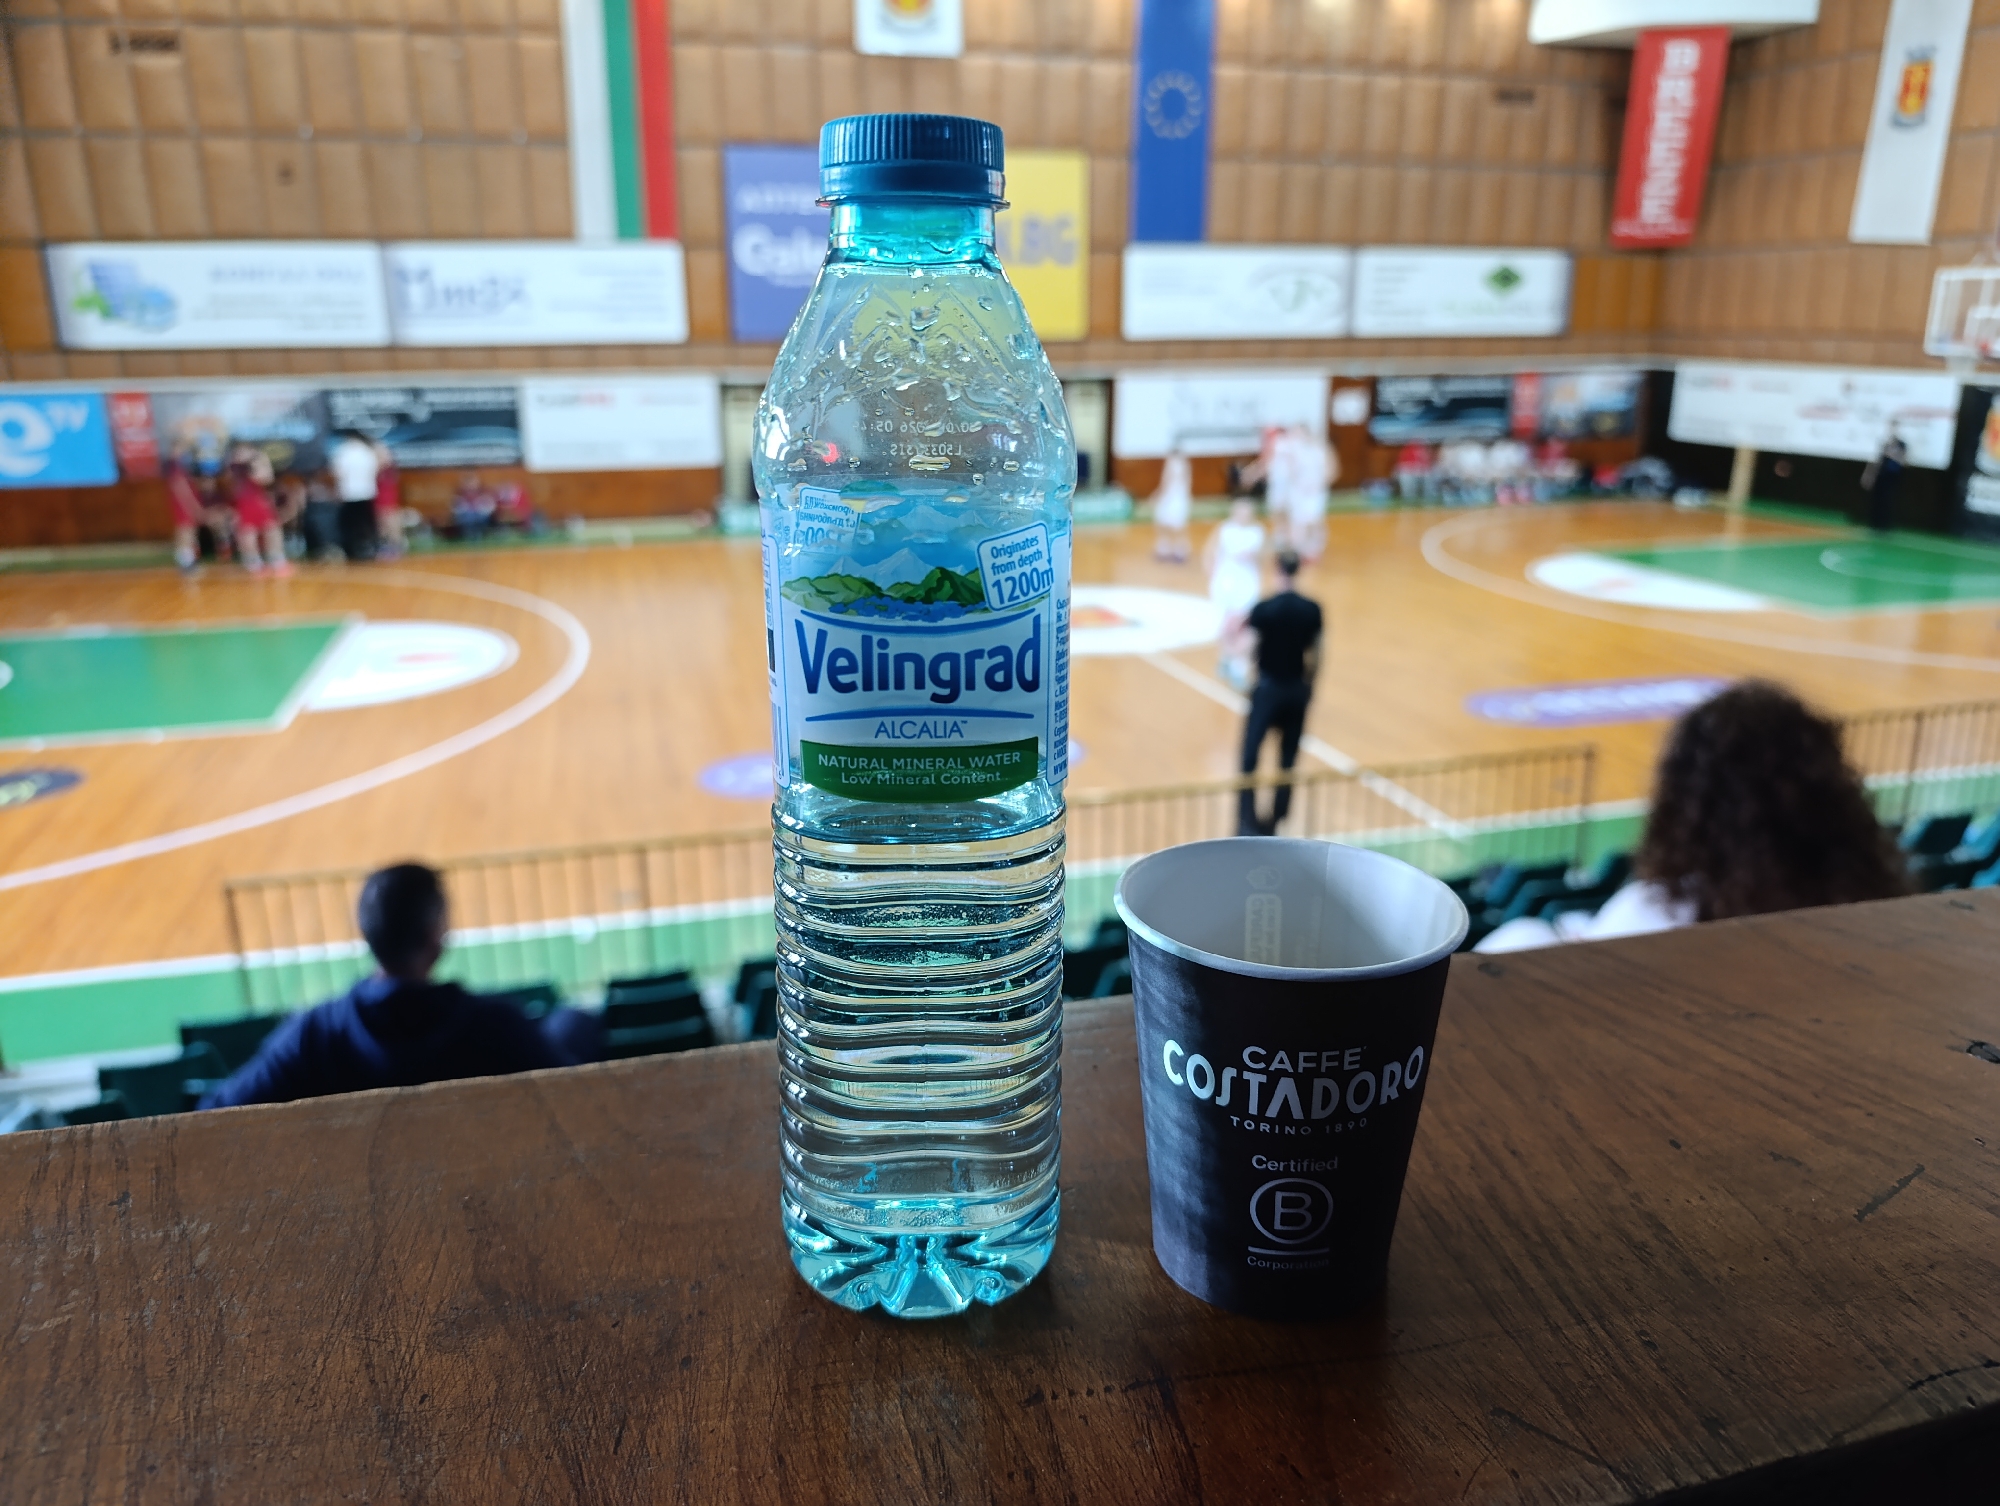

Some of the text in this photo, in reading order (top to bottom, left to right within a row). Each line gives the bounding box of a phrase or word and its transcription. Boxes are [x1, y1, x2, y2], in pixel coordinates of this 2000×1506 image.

[990, 535, 1040, 559] Originates
[991, 549, 1043, 576] from depth
[991, 567, 1054, 605] 1200m
[794, 614, 1041, 704] Velingrad
[818, 752, 1021, 770] NATURAL MINERAL WATER
[841, 771, 1001, 785] Low Mineral Content
[1163, 1039, 1424, 1120] COSTADORO
[1230, 1115, 1368, 1136] TORINO 1890
[1251, 1154, 1339, 1172] Certified
[1273, 1190, 1312, 1231] B
[1247, 1255, 1330, 1271] Corporation
